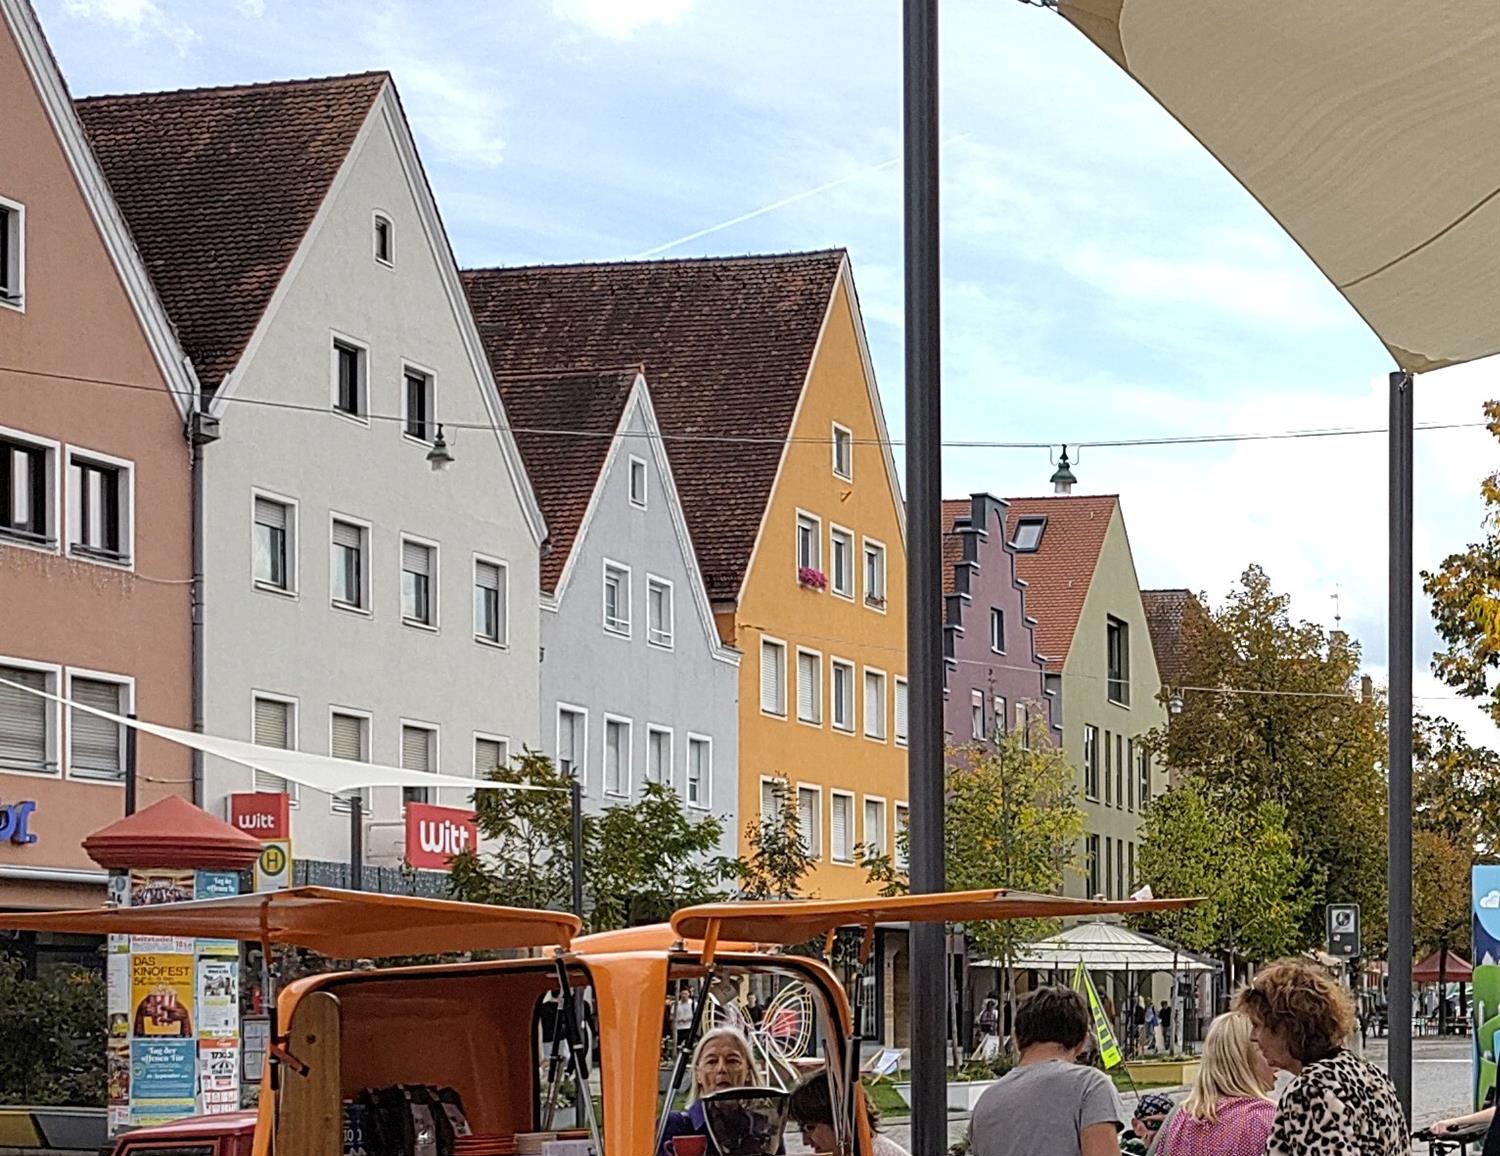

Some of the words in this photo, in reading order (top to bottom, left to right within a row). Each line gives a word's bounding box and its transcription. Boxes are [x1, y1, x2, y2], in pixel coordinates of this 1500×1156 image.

[238, 813, 275, 829] Witt
[420, 820, 469, 855] Witt
[266, 851, 278, 868] H
[133, 956, 156, 966] DAS
[133, 966, 191, 977] KINOFEST
